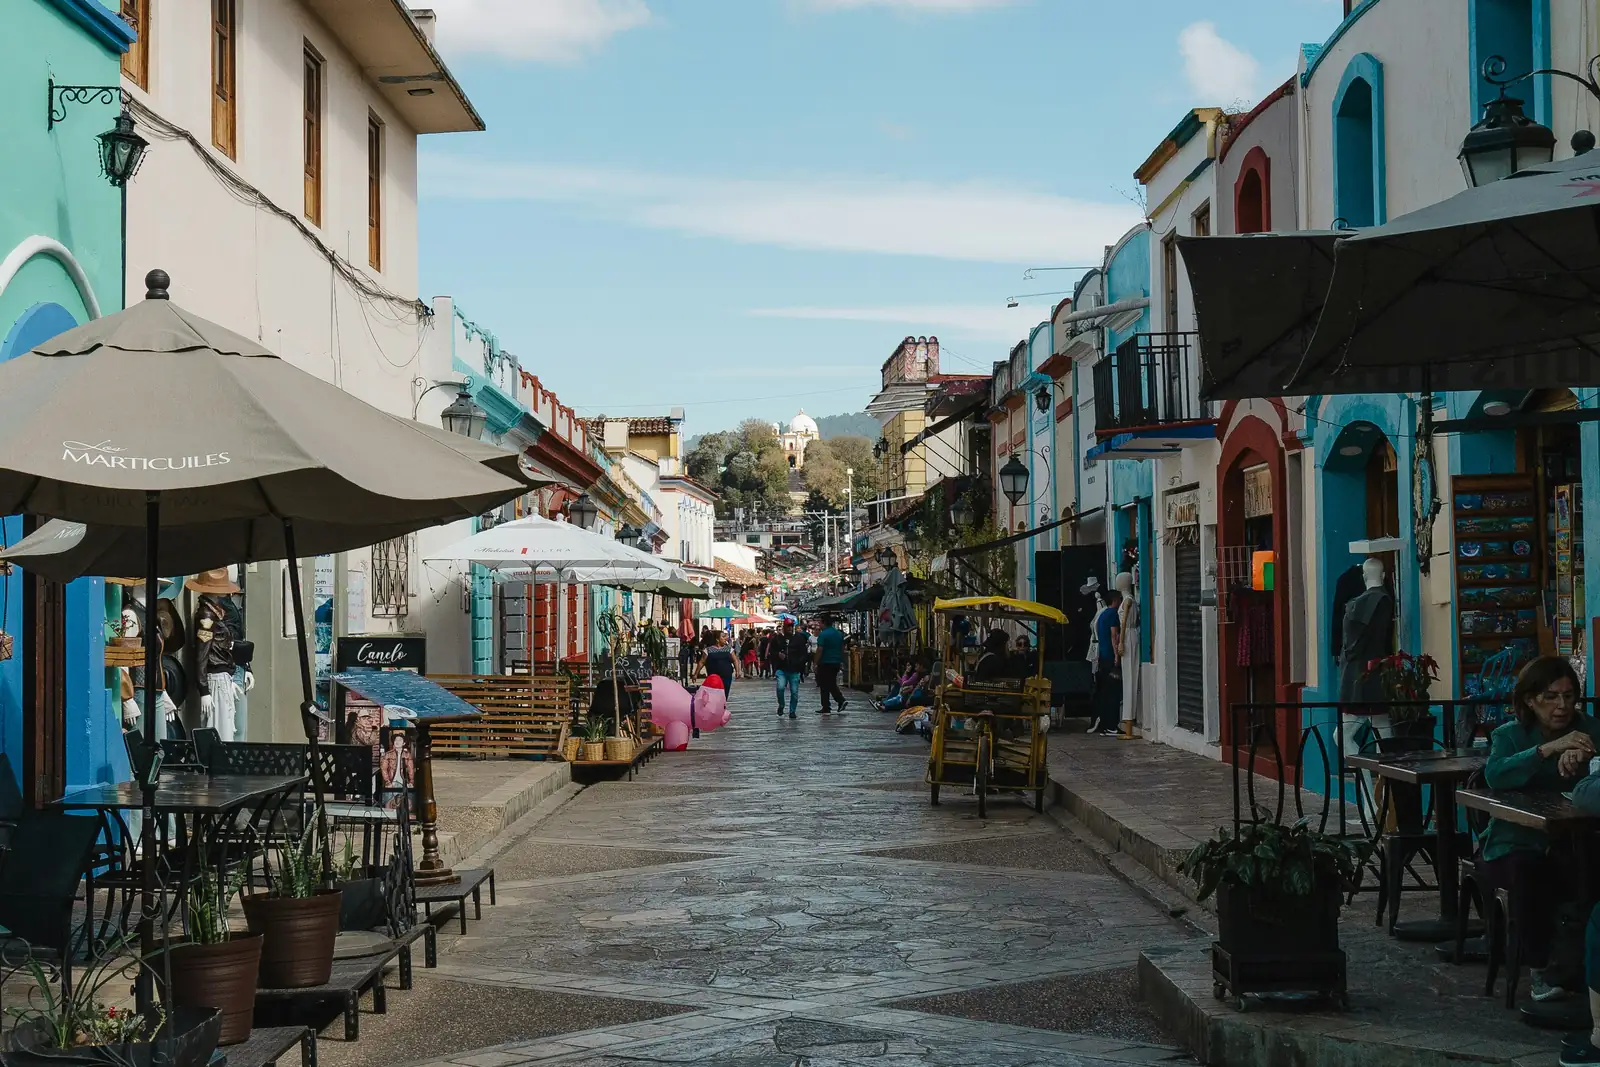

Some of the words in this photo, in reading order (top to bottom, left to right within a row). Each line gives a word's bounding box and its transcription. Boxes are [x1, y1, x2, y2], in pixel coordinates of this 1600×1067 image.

[62, 439, 128, 454] Los
[62, 448, 231, 470] MARTICUILES
[357, 642, 408, 663] Canelo
